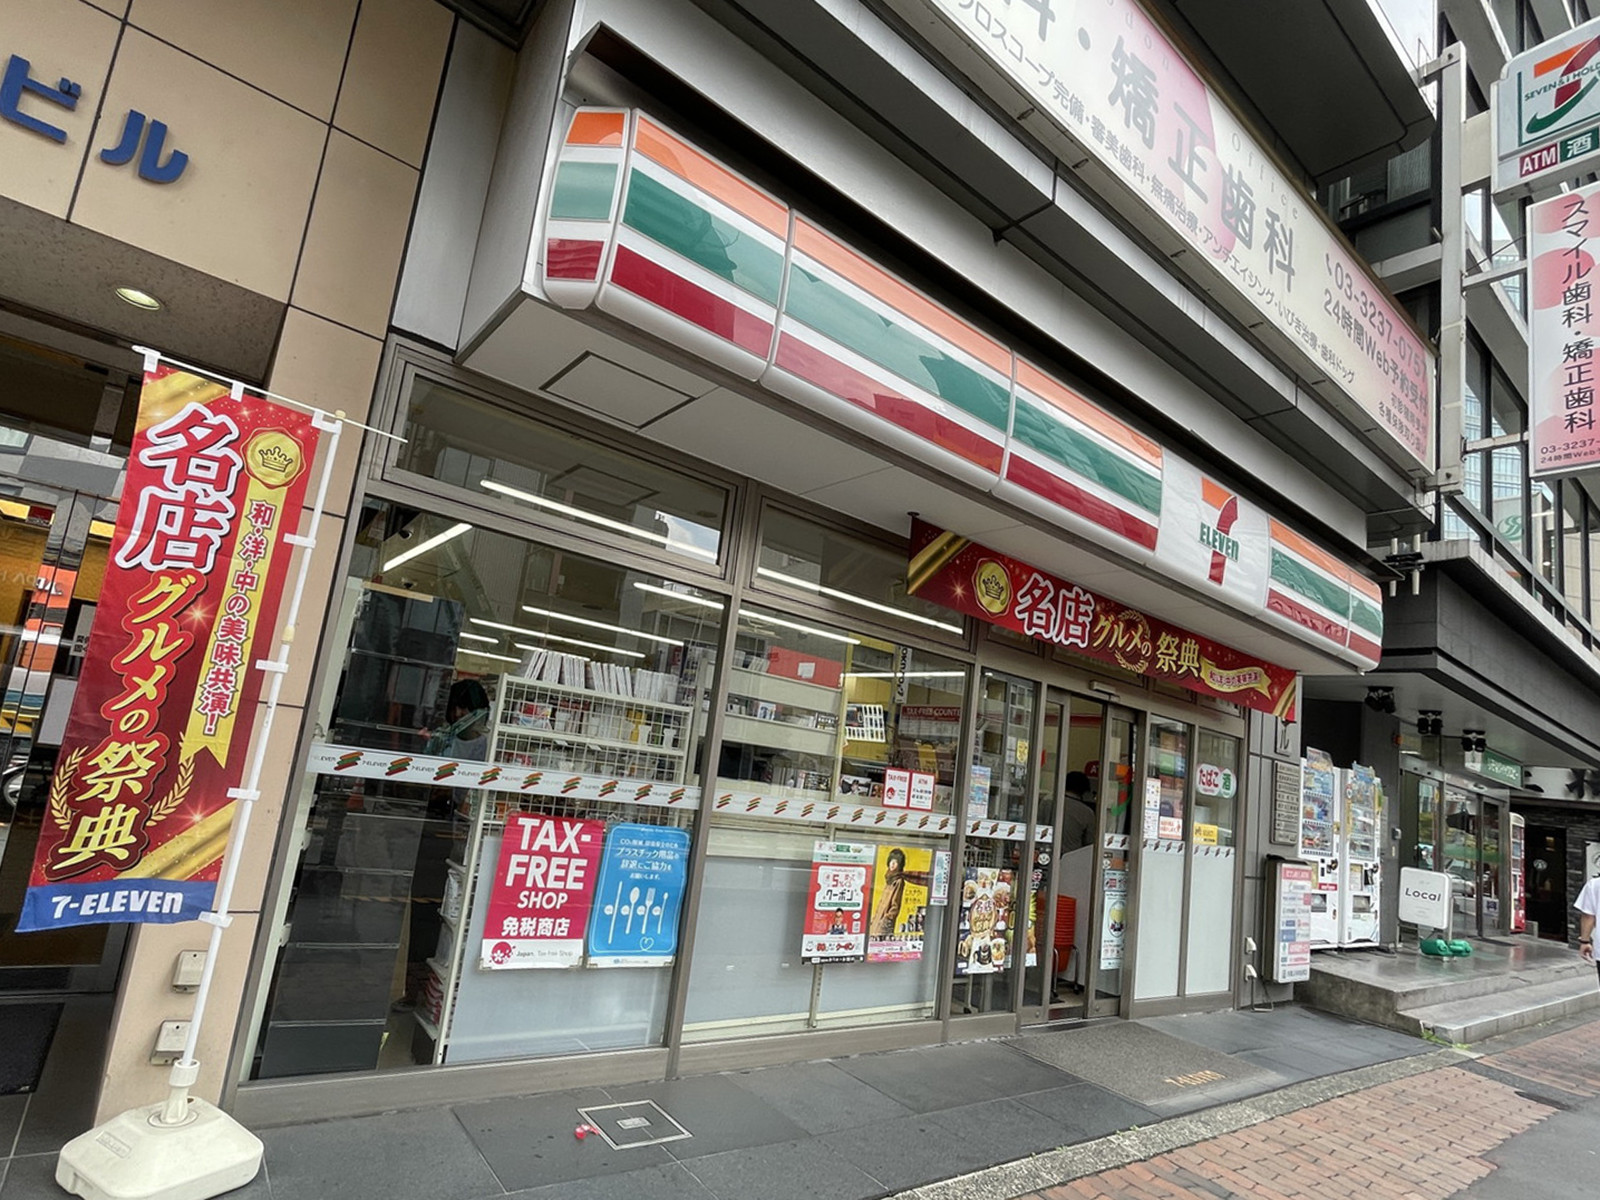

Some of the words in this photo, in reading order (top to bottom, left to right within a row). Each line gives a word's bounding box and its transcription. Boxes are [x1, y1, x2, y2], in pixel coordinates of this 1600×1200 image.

[0, 54, 189, 184] ビル
[1566, 132, 1593, 159] 酒
[1521, 146, 1558, 175] ATM
[1199, 768, 1219, 788] たばこ
[517, 817, 591, 854] TAX-
[505, 854, 588, 890] FREE
[517, 890, 568, 909] SHOP
[1405, 887, 1441, 902] Local
[501, 916, 570, 937] 免税商店
